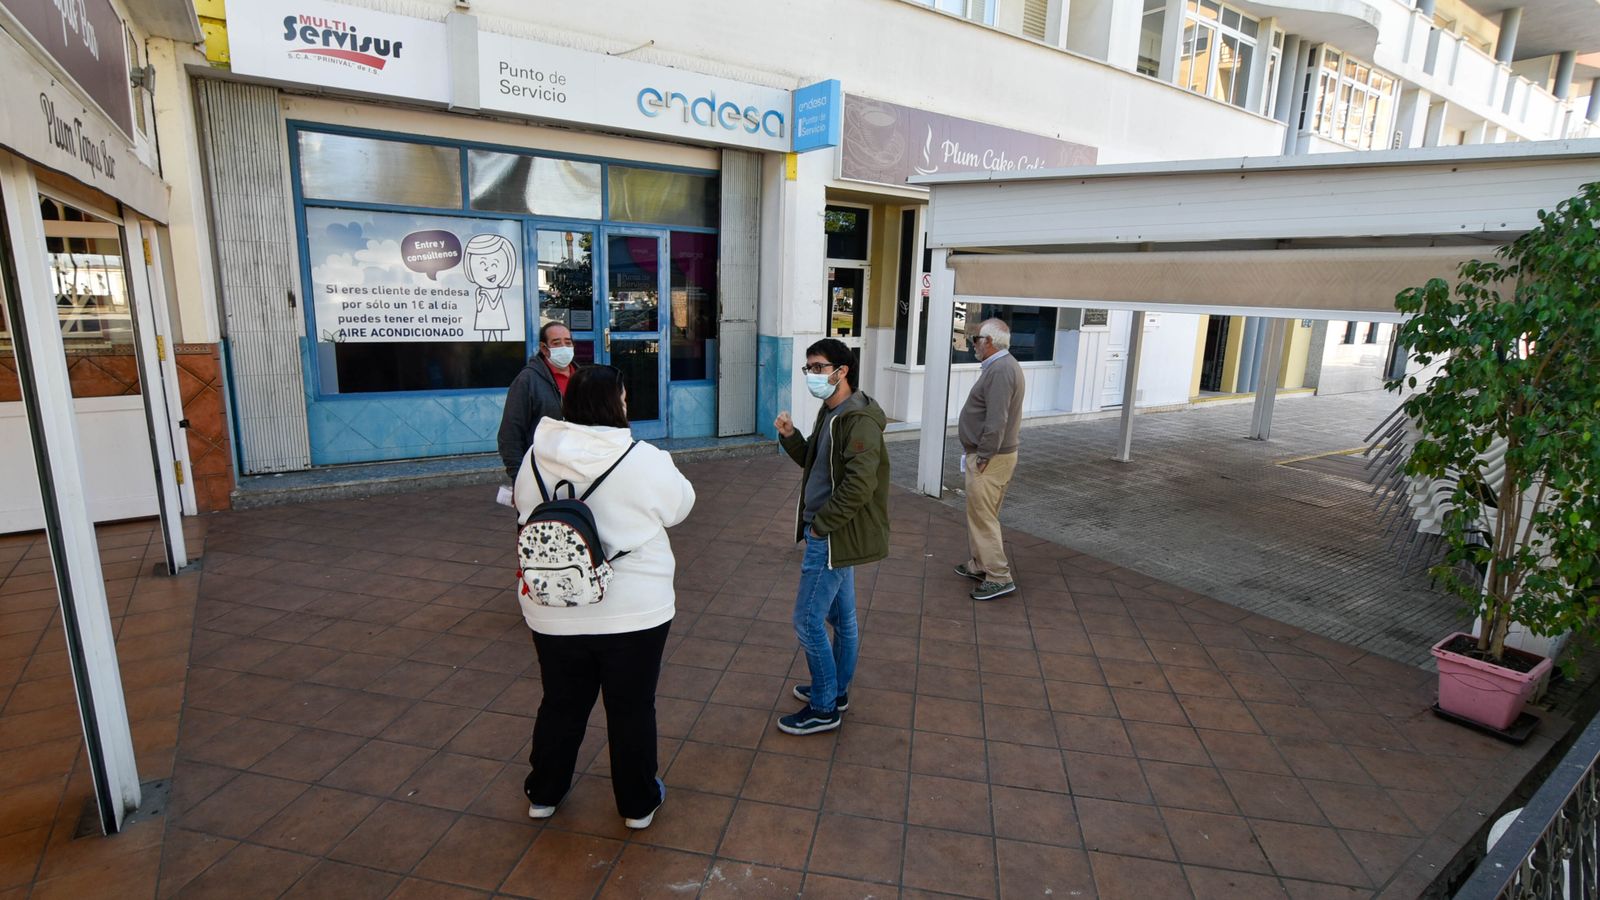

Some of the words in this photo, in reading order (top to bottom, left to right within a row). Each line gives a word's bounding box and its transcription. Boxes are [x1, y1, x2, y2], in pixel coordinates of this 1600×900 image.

[299, 14, 347, 32] MULTI
[283, 15, 403, 59] Servisur
[499, 61, 544, 82] Punto
[549, 72, 567, 86] de
[499, 79, 567, 103] Servicio
[637, 87, 786, 138] endesa
[799, 96, 827, 112] endesa
[40, 92, 76, 158] Plum
[941, 140, 981, 168] Plum
[982, 149, 1016, 171] Cake
[414, 241, 439, 250] Entre
[439, 240, 445, 249] y
[407, 250, 458, 262] consúltenos
[341, 286, 369, 295] eres
[371, 285, 411, 296] cliente
[413, 286, 428, 296] de
[430, 287, 470, 297] endesa
[342, 301, 361, 311] por
[366, 299, 391, 310] sólo
[393, 302, 408, 310] un
[411, 300, 425, 310] 1€
[428, 301, 439, 310] al
[338, 314, 381, 325] puedes
[384, 314, 415, 324] tener
[417, 314, 429, 324] el
[431, 315, 464, 326] mejor
[338, 327, 368, 338] AIRE
[370, 327, 464, 338] ACONDICIONADO
